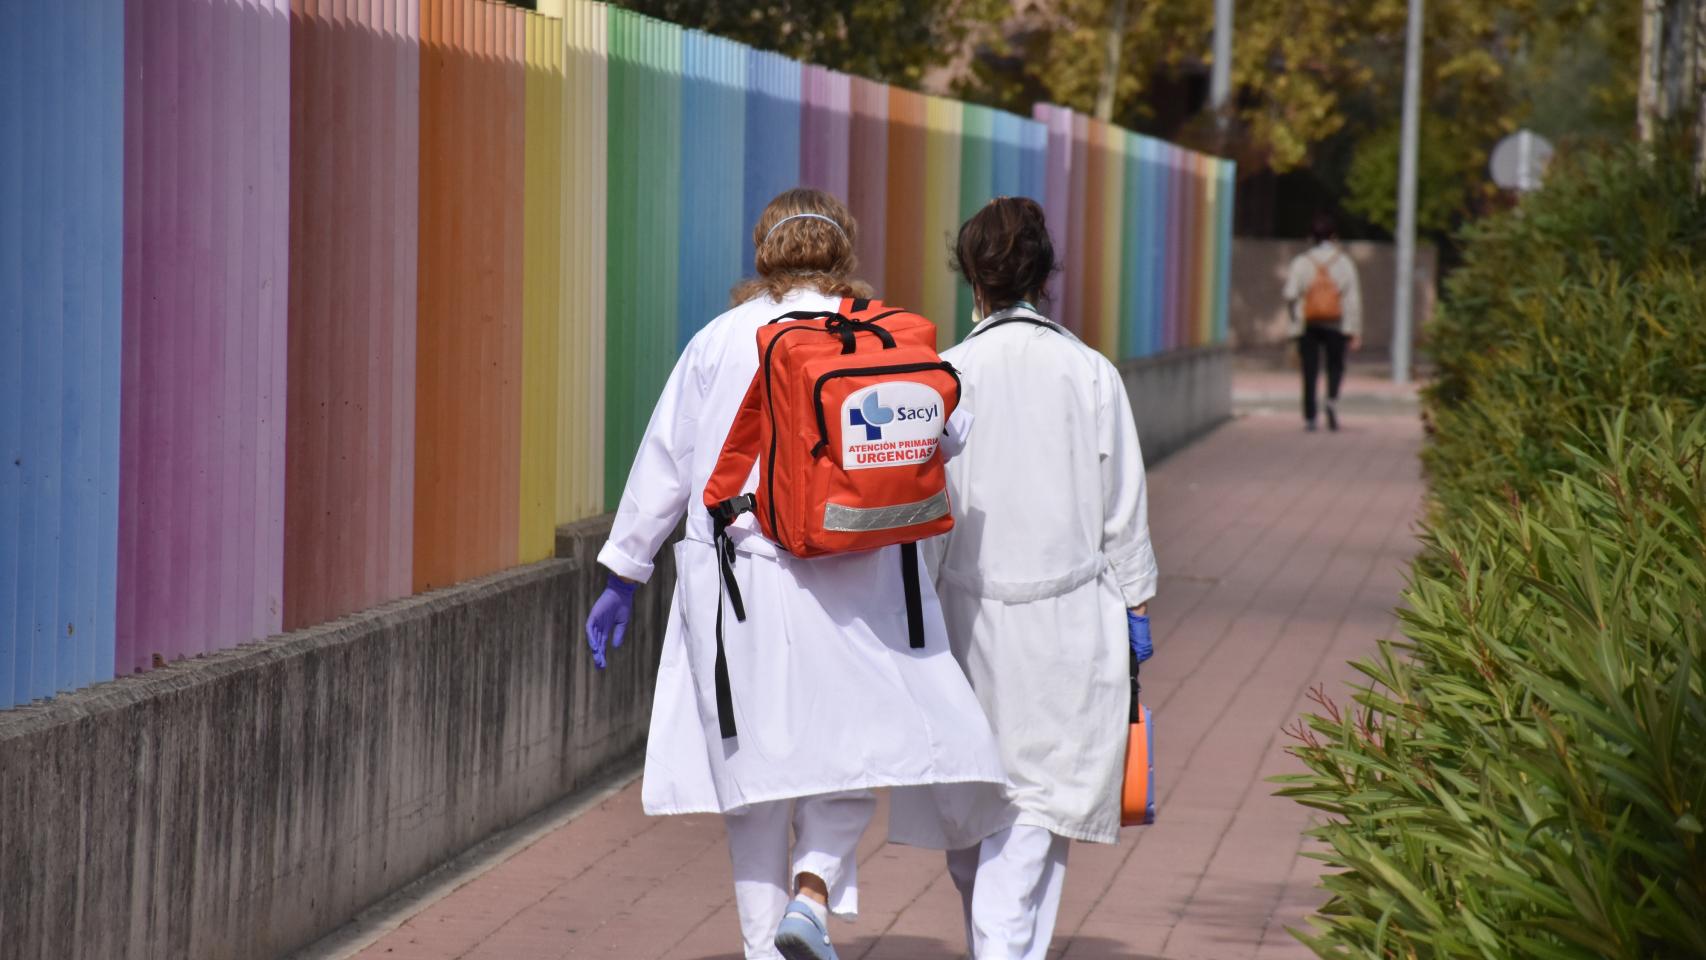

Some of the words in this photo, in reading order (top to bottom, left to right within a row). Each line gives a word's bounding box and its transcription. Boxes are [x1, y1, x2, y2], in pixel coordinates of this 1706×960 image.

[897, 404, 938, 422] Sacyl
[848, 442, 896, 453] ATENCIÓN
[856, 447, 932, 464] URGENCIAS
